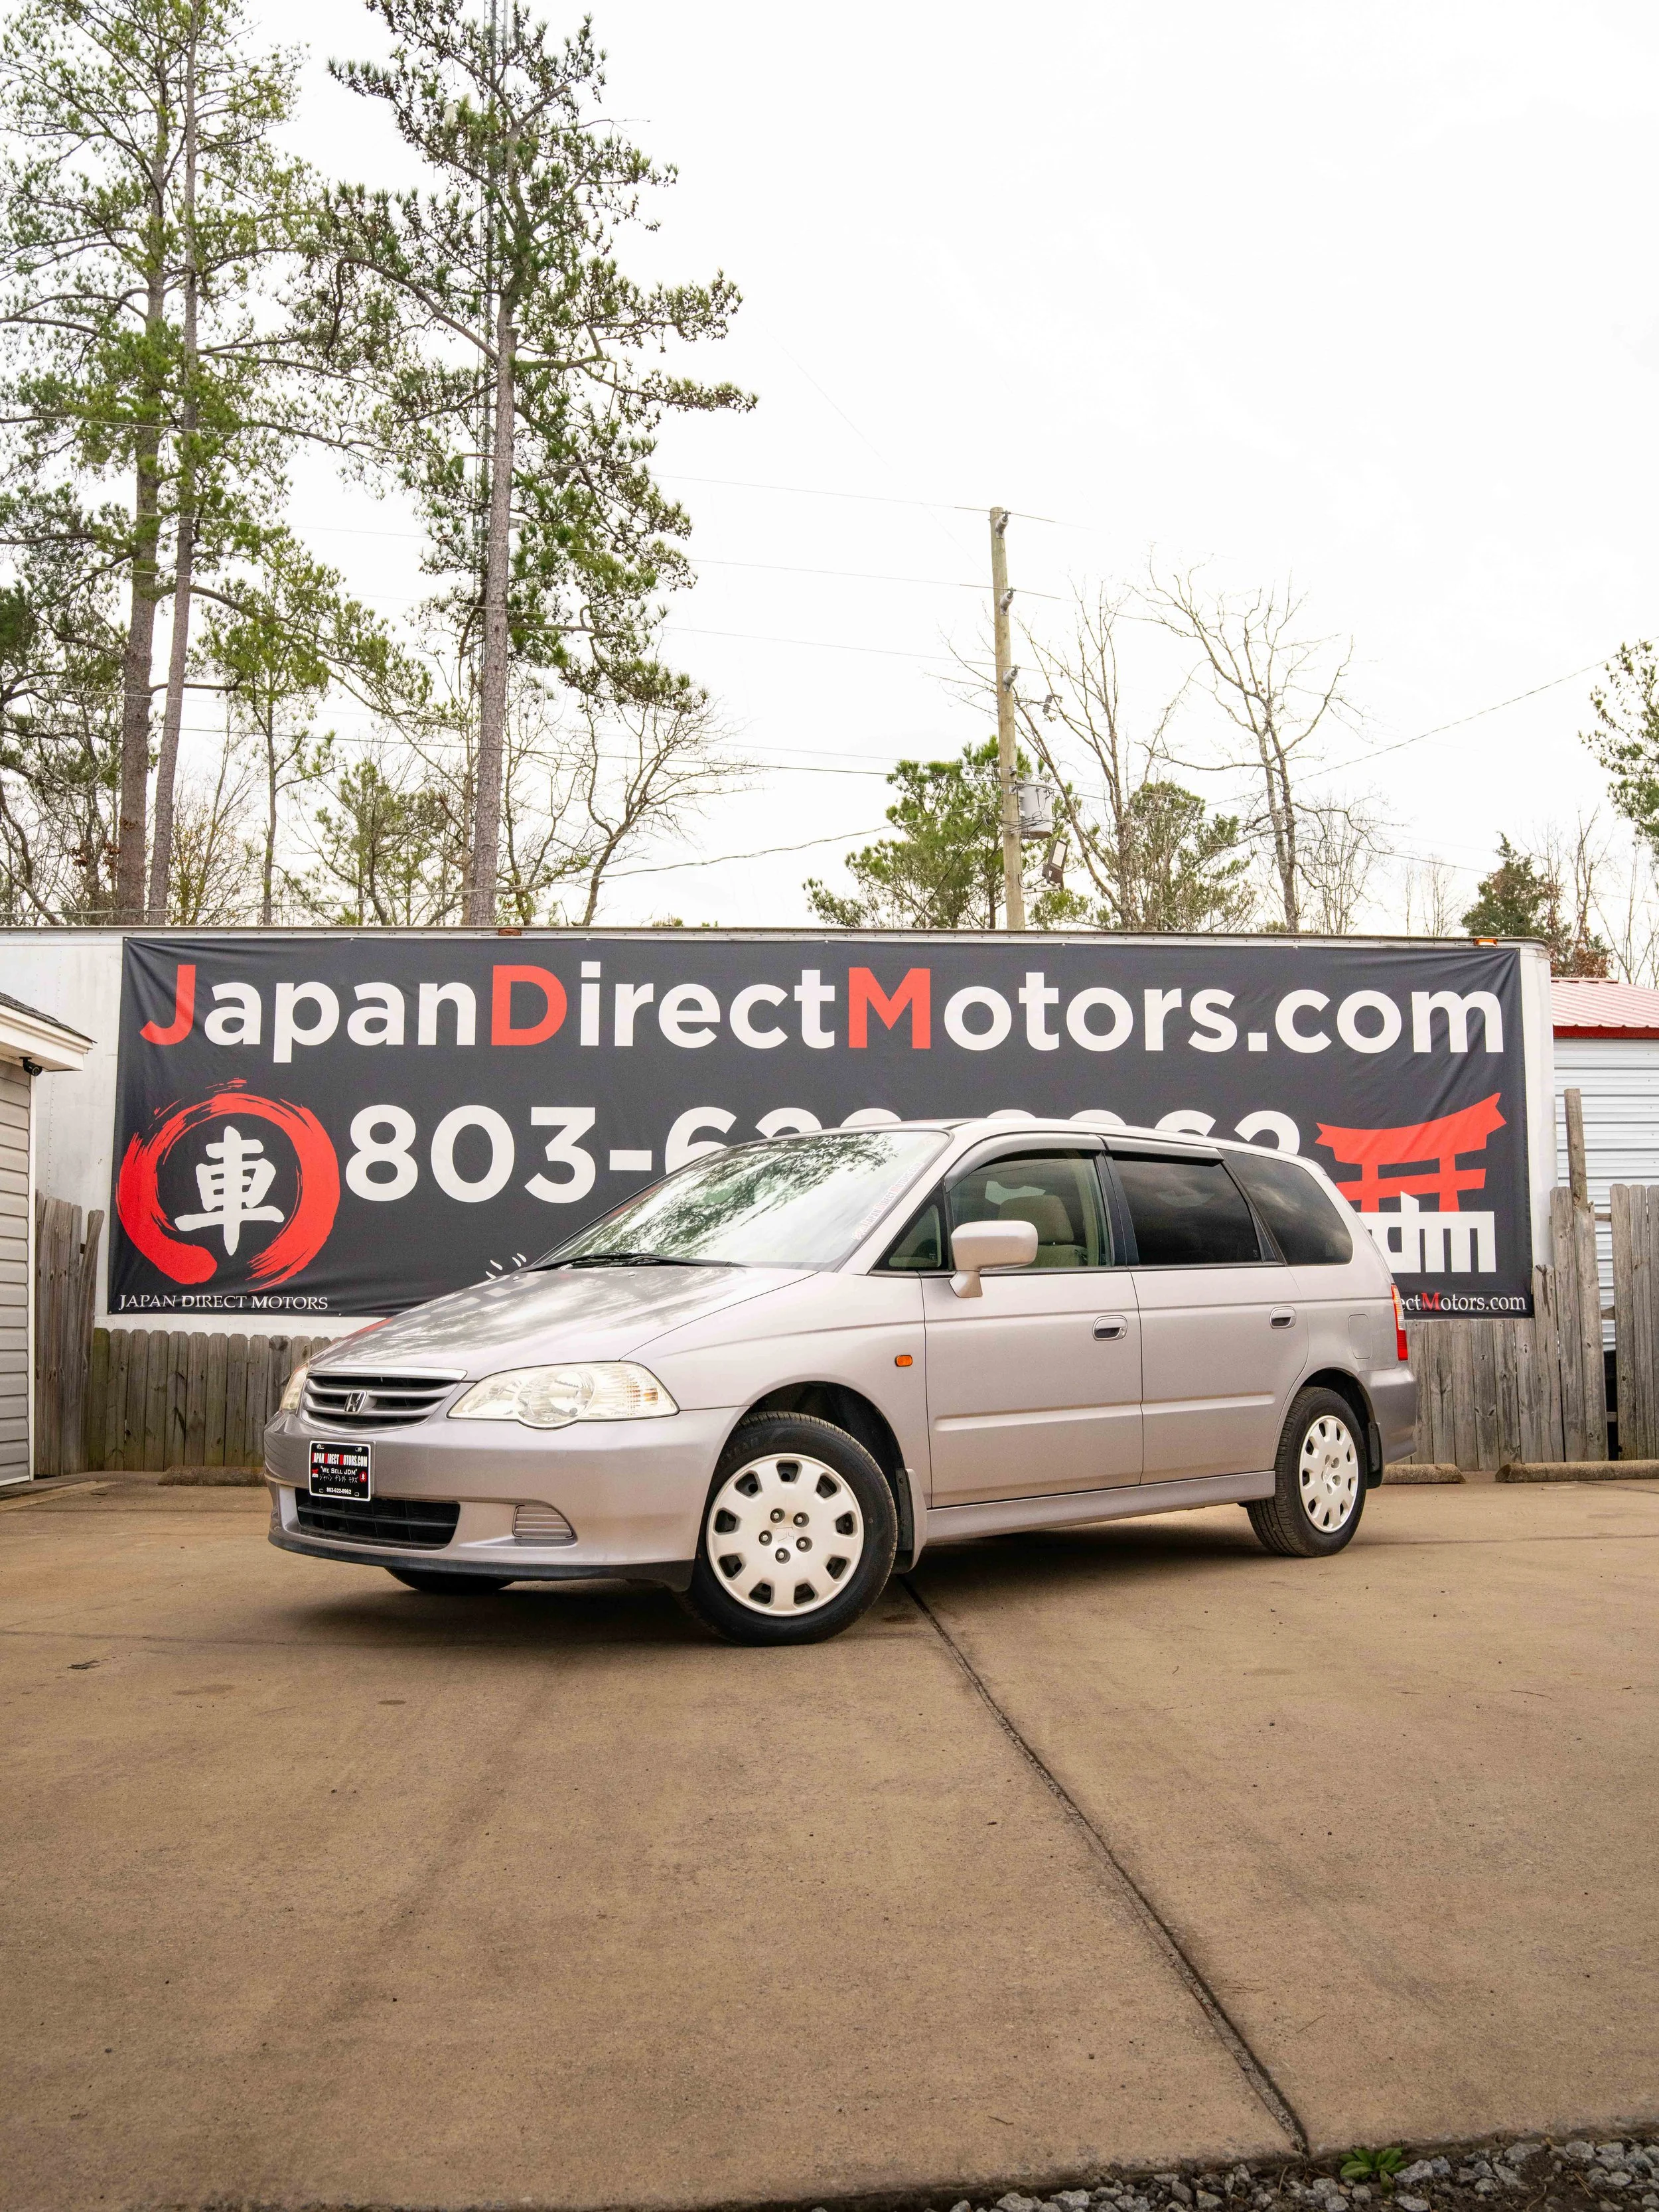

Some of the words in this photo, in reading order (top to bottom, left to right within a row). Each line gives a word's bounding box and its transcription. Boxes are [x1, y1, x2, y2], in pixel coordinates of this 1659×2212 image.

[139, 960, 1504, 1063] JapanDirectMotors.com
[175, 1126, 285, 1256] 車
[1356, 1191, 1496, 1273] dm
[118, 1295, 176, 1311] JAPAN
[181, 1295, 248, 1308] DIRECT
[250, 1295, 328, 1310] MOTORS
